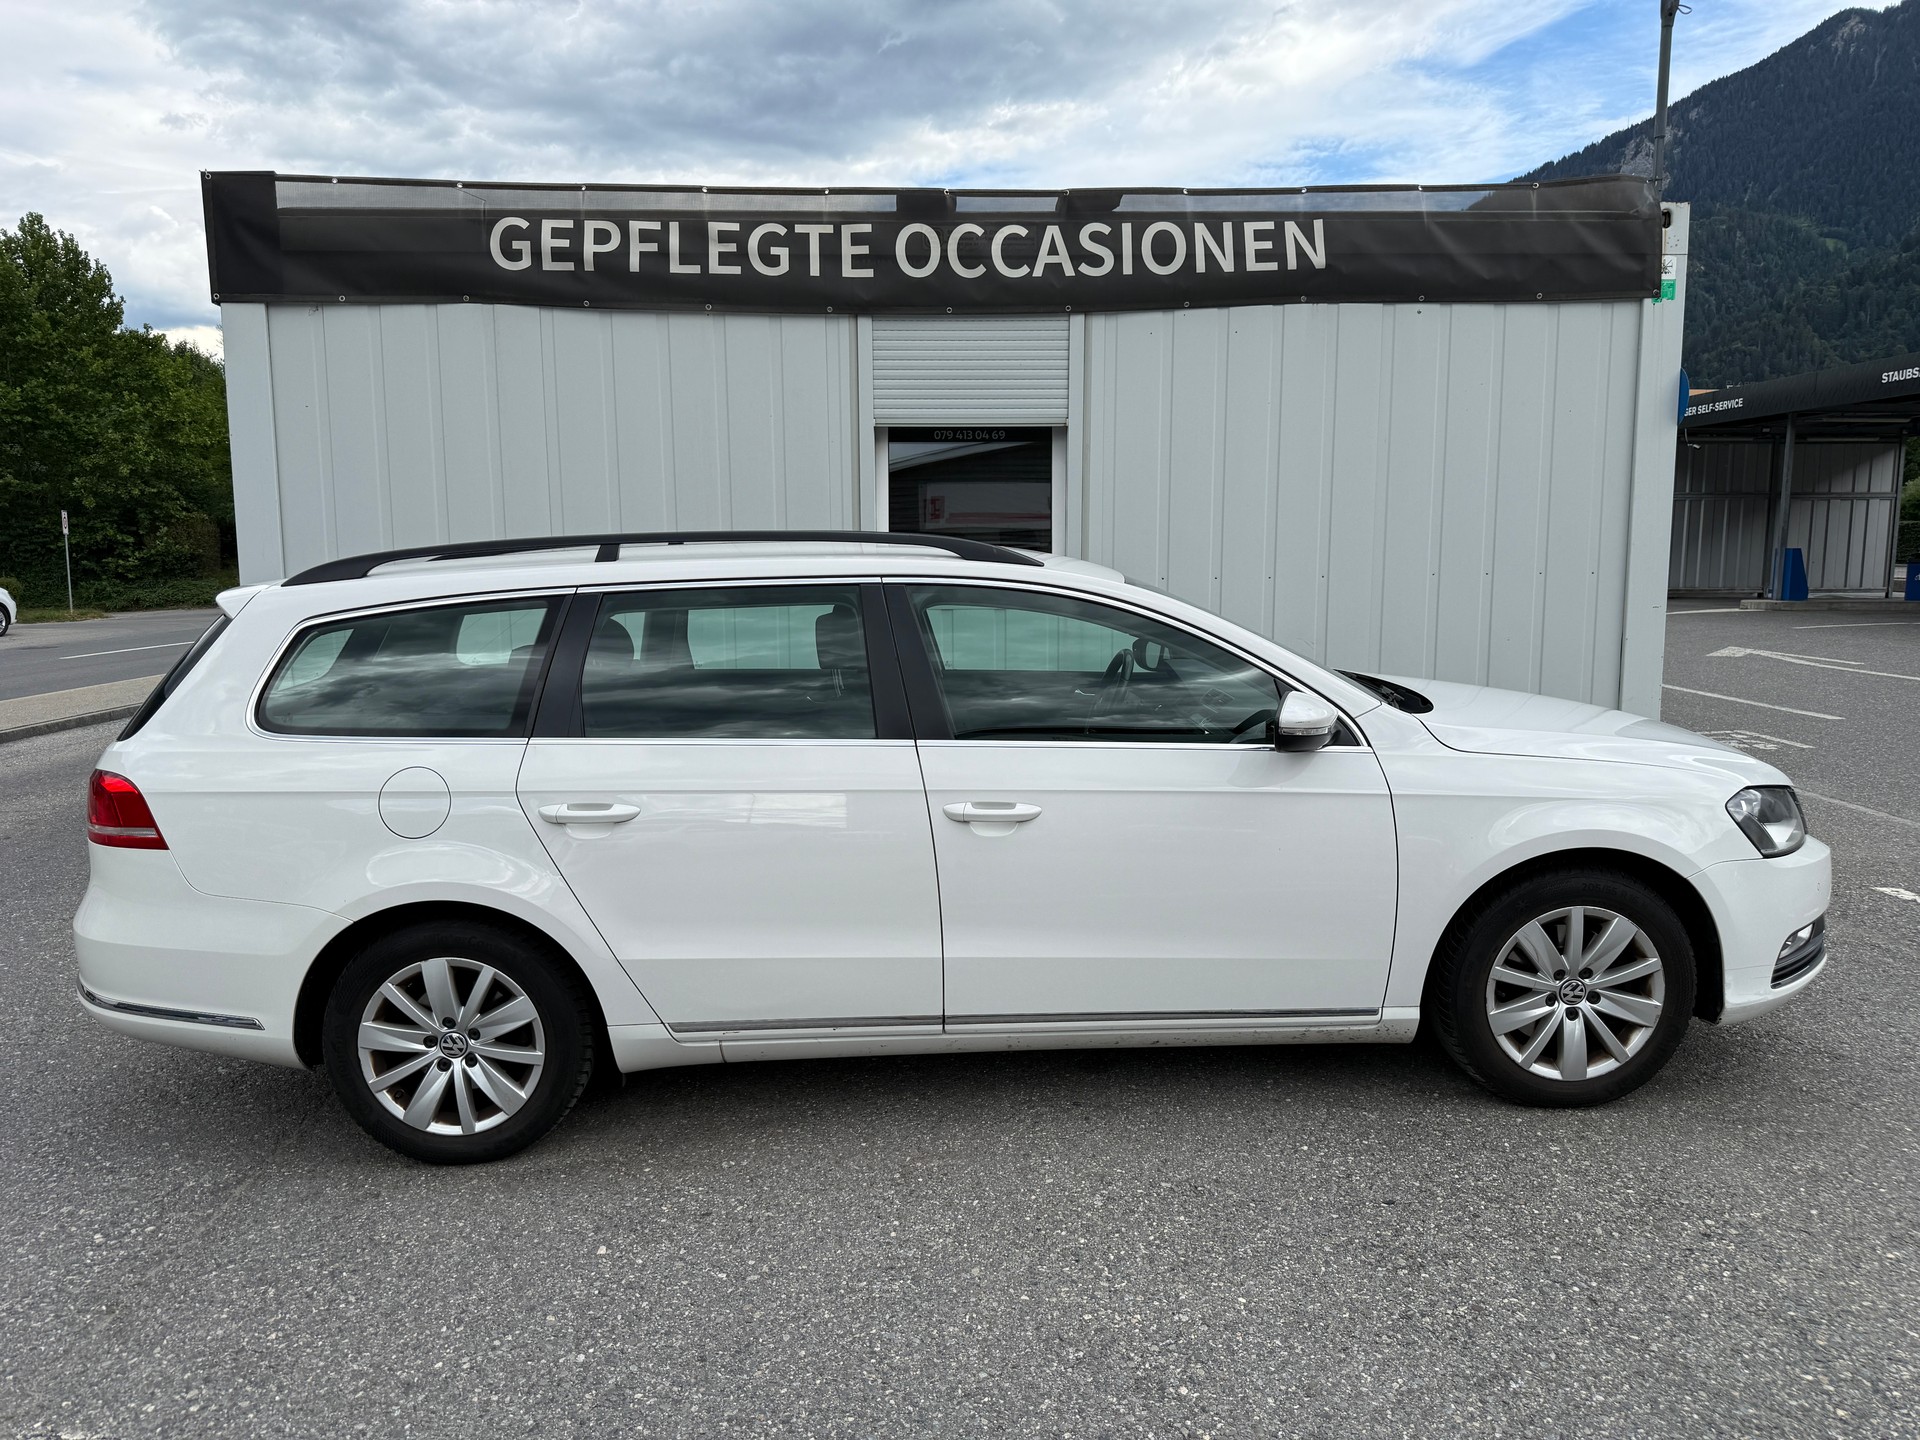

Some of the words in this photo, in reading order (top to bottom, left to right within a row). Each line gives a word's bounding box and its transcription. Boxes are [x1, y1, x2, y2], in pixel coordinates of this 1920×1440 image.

[489, 216, 875, 279] GEPFLEGTE
[895, 218, 1327, 279] OCCASIONEN
[1881, 367, 1920, 384] STAUBS
[1697, 398, 1744, 415] SELF-SERVICE
[934, 430, 954, 440] 079
[955, 430, 973, 440] 413
[975, 430, 990, 440] 04
[991, 430, 1006, 440] 69
